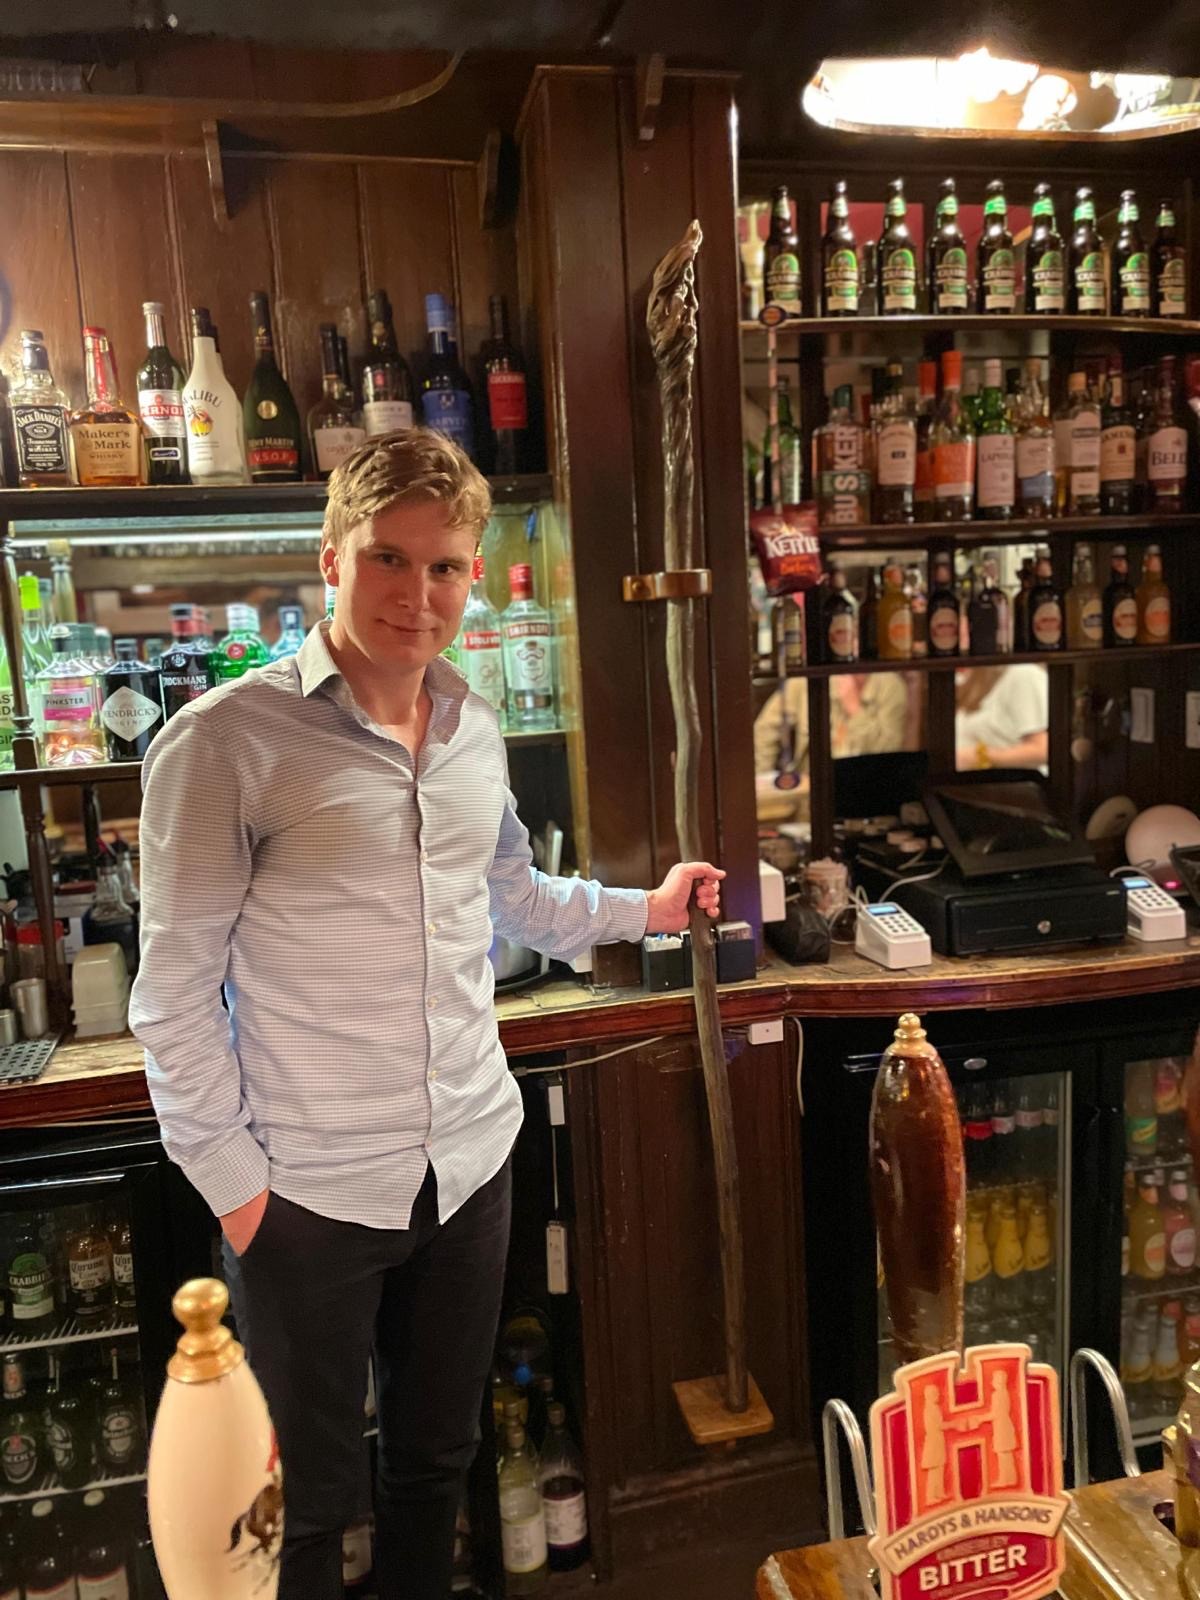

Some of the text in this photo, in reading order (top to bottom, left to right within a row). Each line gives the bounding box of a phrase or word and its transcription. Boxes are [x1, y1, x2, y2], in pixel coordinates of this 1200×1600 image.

[16, 413, 34, 428] JACK
[79, 429, 130, 439] Maker's
[94, 440, 131, 449] Mark
[763, 534, 820, 558] KETTLE
[894, 1518, 957, 1560] HARDYS
[960, 1510, 971, 1528] &
[974, 1506, 1054, 1528] HANSONS
[918, 1544, 1028, 1592] BITTER
